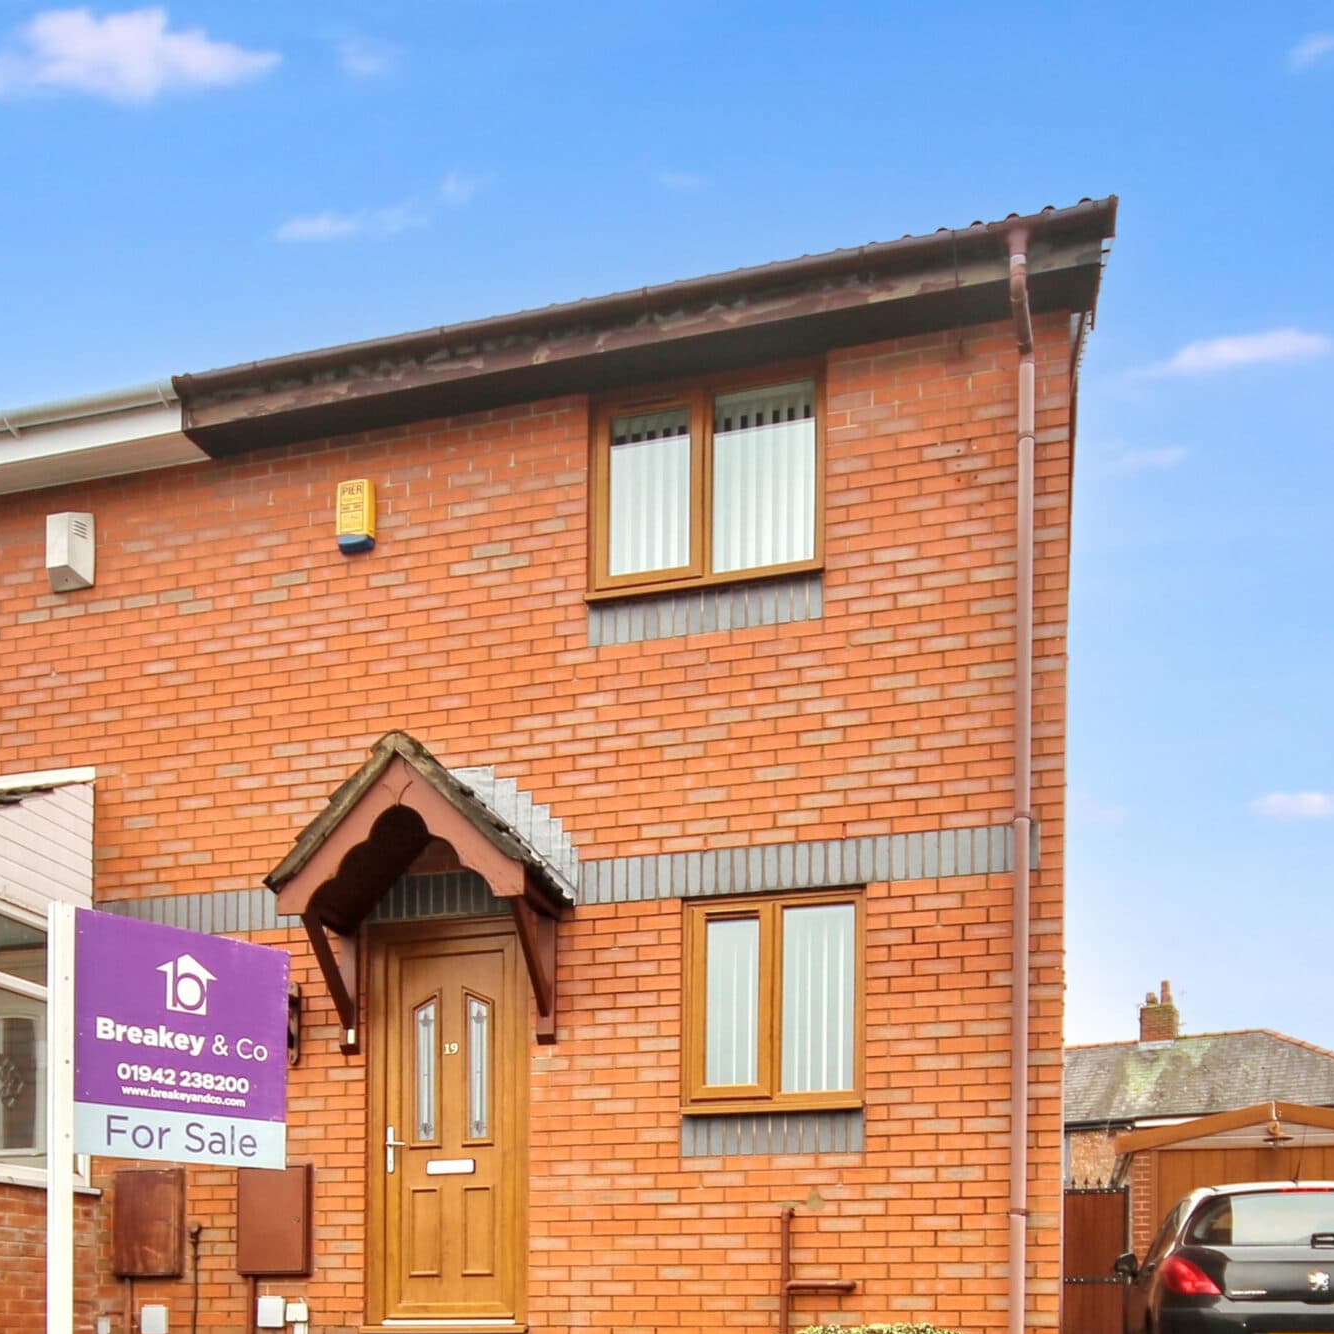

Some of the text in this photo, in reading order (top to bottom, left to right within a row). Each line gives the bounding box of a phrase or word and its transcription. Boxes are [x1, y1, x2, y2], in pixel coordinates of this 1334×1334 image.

[342, 485, 363, 496] PIER
[96, 1016, 268, 1061] Breakey & Co
[444, 1042, 459, 1055] 19
[117, 1062, 249, 1093] 01942 238200
[121, 1086, 246, 1107] www.breakeyandco.com
[107, 1114, 257, 1157] For Sale
